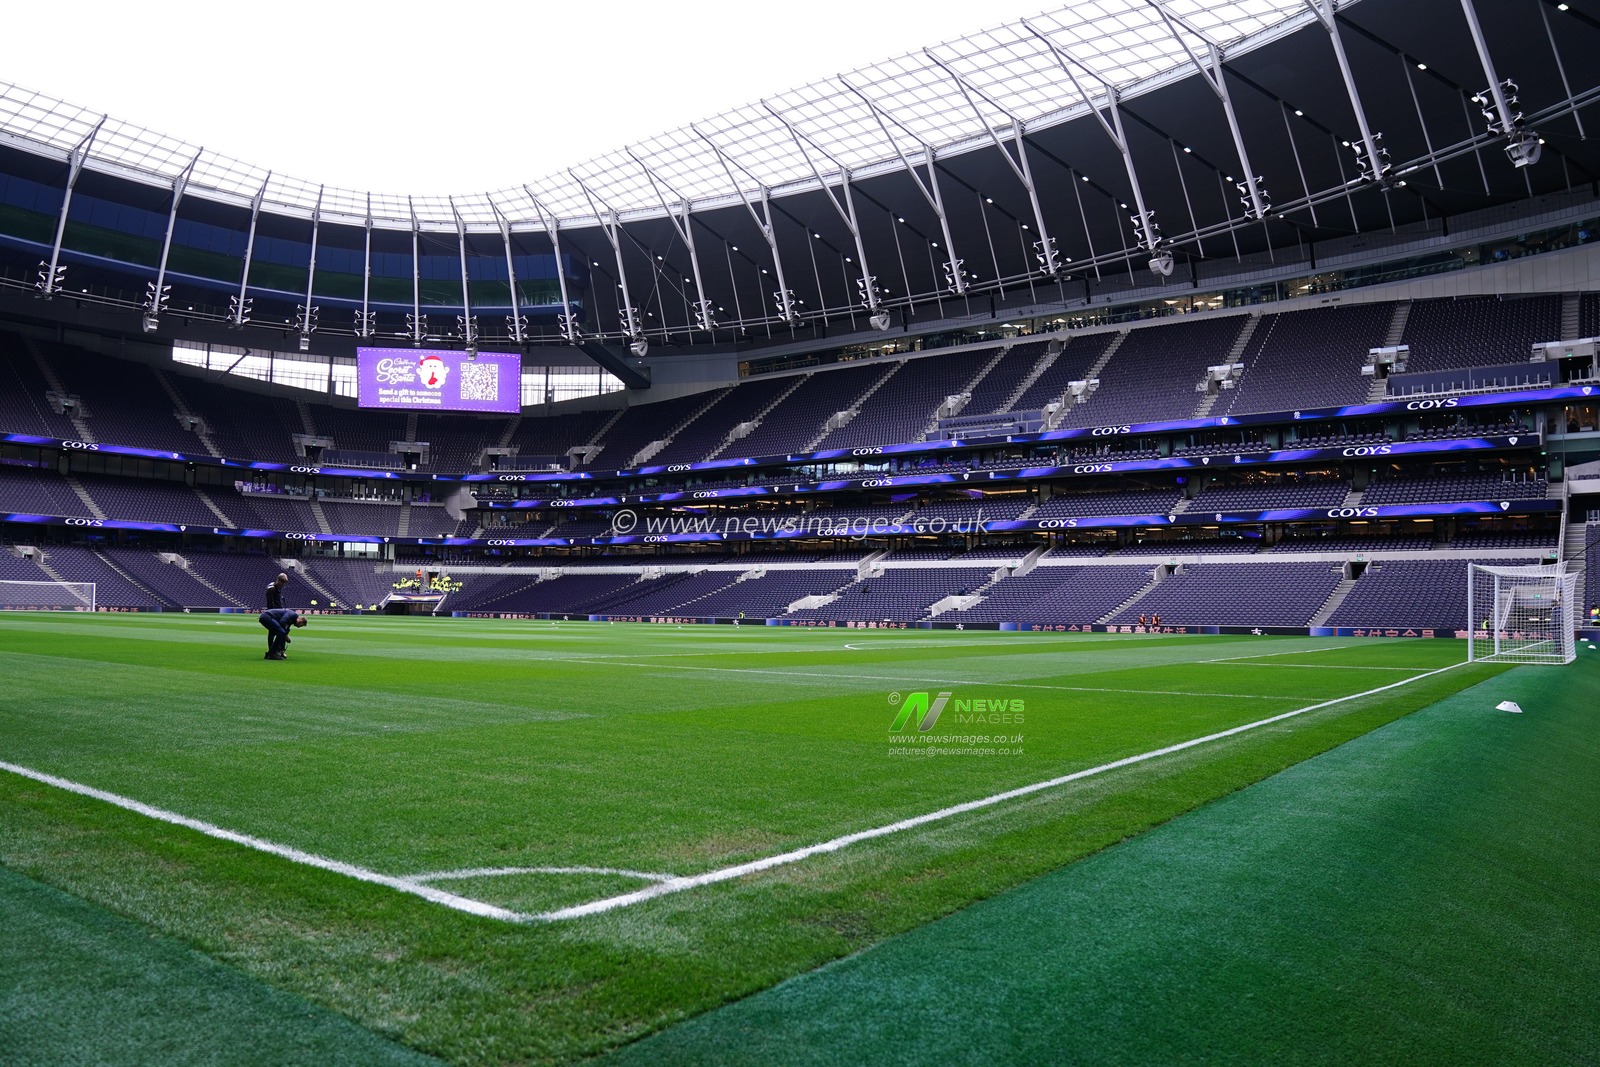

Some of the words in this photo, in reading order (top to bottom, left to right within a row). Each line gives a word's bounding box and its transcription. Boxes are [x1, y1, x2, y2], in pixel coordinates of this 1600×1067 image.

[376, 358, 412, 382] Secret
[389, 372, 416, 385] Santa
[378, 388, 394, 396] Send
[399, 388, 409, 397] gift
[379, 396, 400, 404] special
[401, 396, 412, 404] this
[412, 396, 442, 405] Christmas
[1406, 397, 1459, 411] COYS
[1091, 425, 1131, 436] COYS
[62, 440, 99, 451] COYS
[1342, 444, 1392, 457] COYS
[851, 447, 883, 456] COYS
[290, 465, 321, 474] COYS
[667, 464, 692, 472] COYS
[1074, 463, 1113, 474] COYS
[861, 478, 893, 488] COYS
[693, 490, 718, 498] COYS
[1327, 507, 1379, 519] COYS
[65, 517, 104, 527] COYS
[1038, 518, 1078, 529] COYS
[285, 532, 317, 540] COYS
[643, 534, 669, 543] COYS
